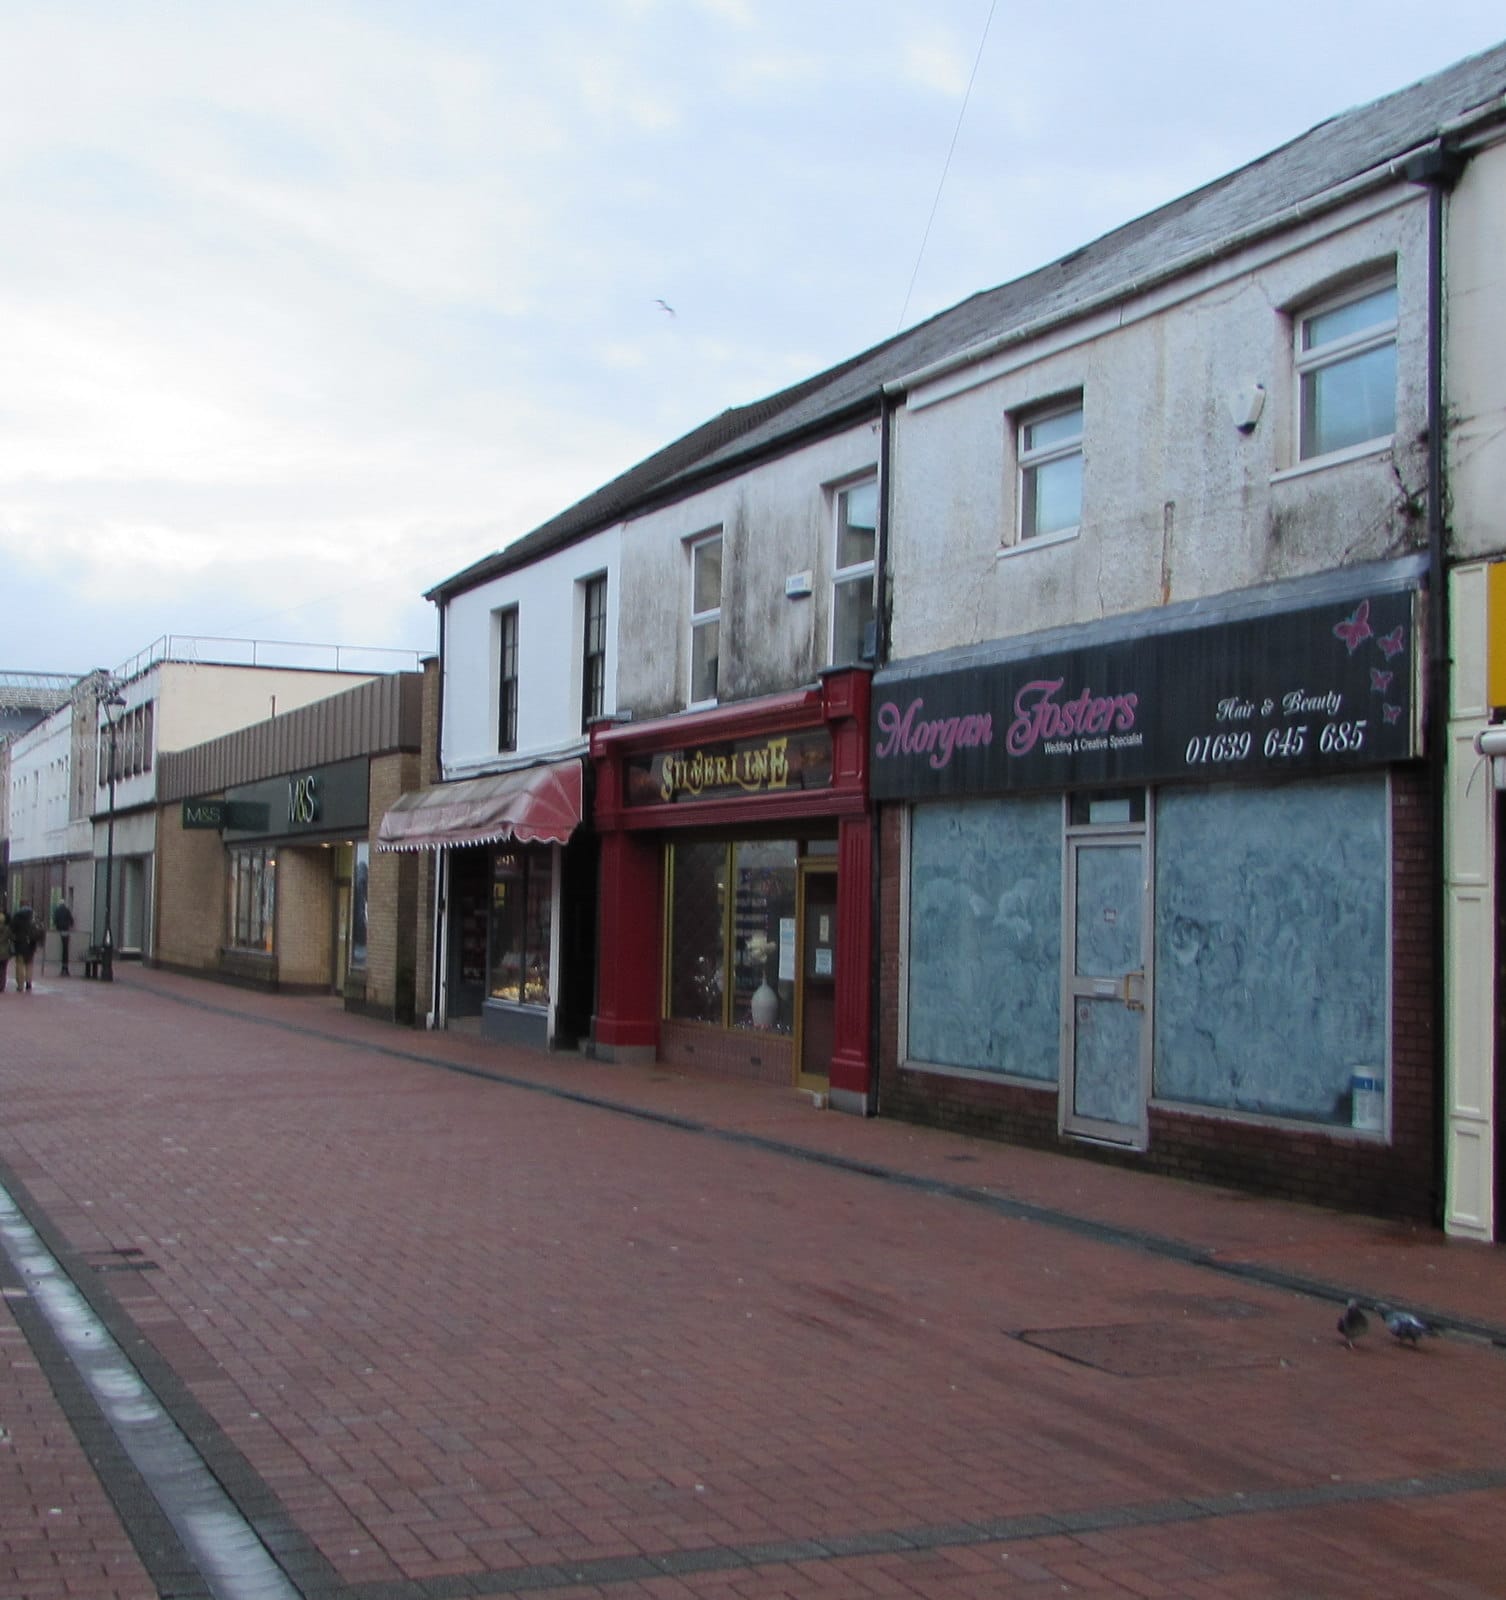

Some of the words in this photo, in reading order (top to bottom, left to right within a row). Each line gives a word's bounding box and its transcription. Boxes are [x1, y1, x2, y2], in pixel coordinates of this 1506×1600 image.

[876, 697, 993, 769] Morgan
[1006, 676, 1138, 757] Fosters
[1216, 696, 1254, 721] Hair
[1261, 698, 1274, 717] &
[1282, 688, 1342, 716] Beauty
[1044, 741, 1072, 755] Wedding
[1073, 739, 1079, 752] &
[1081, 738, 1108, 751] Creative
[1186, 731, 1251, 765] 01639
[1264, 726, 1308, 758] 645
[1319, 720, 1367, 753] 685
[187, 807, 220, 822] M&S
[287, 775, 315, 823] M&S
